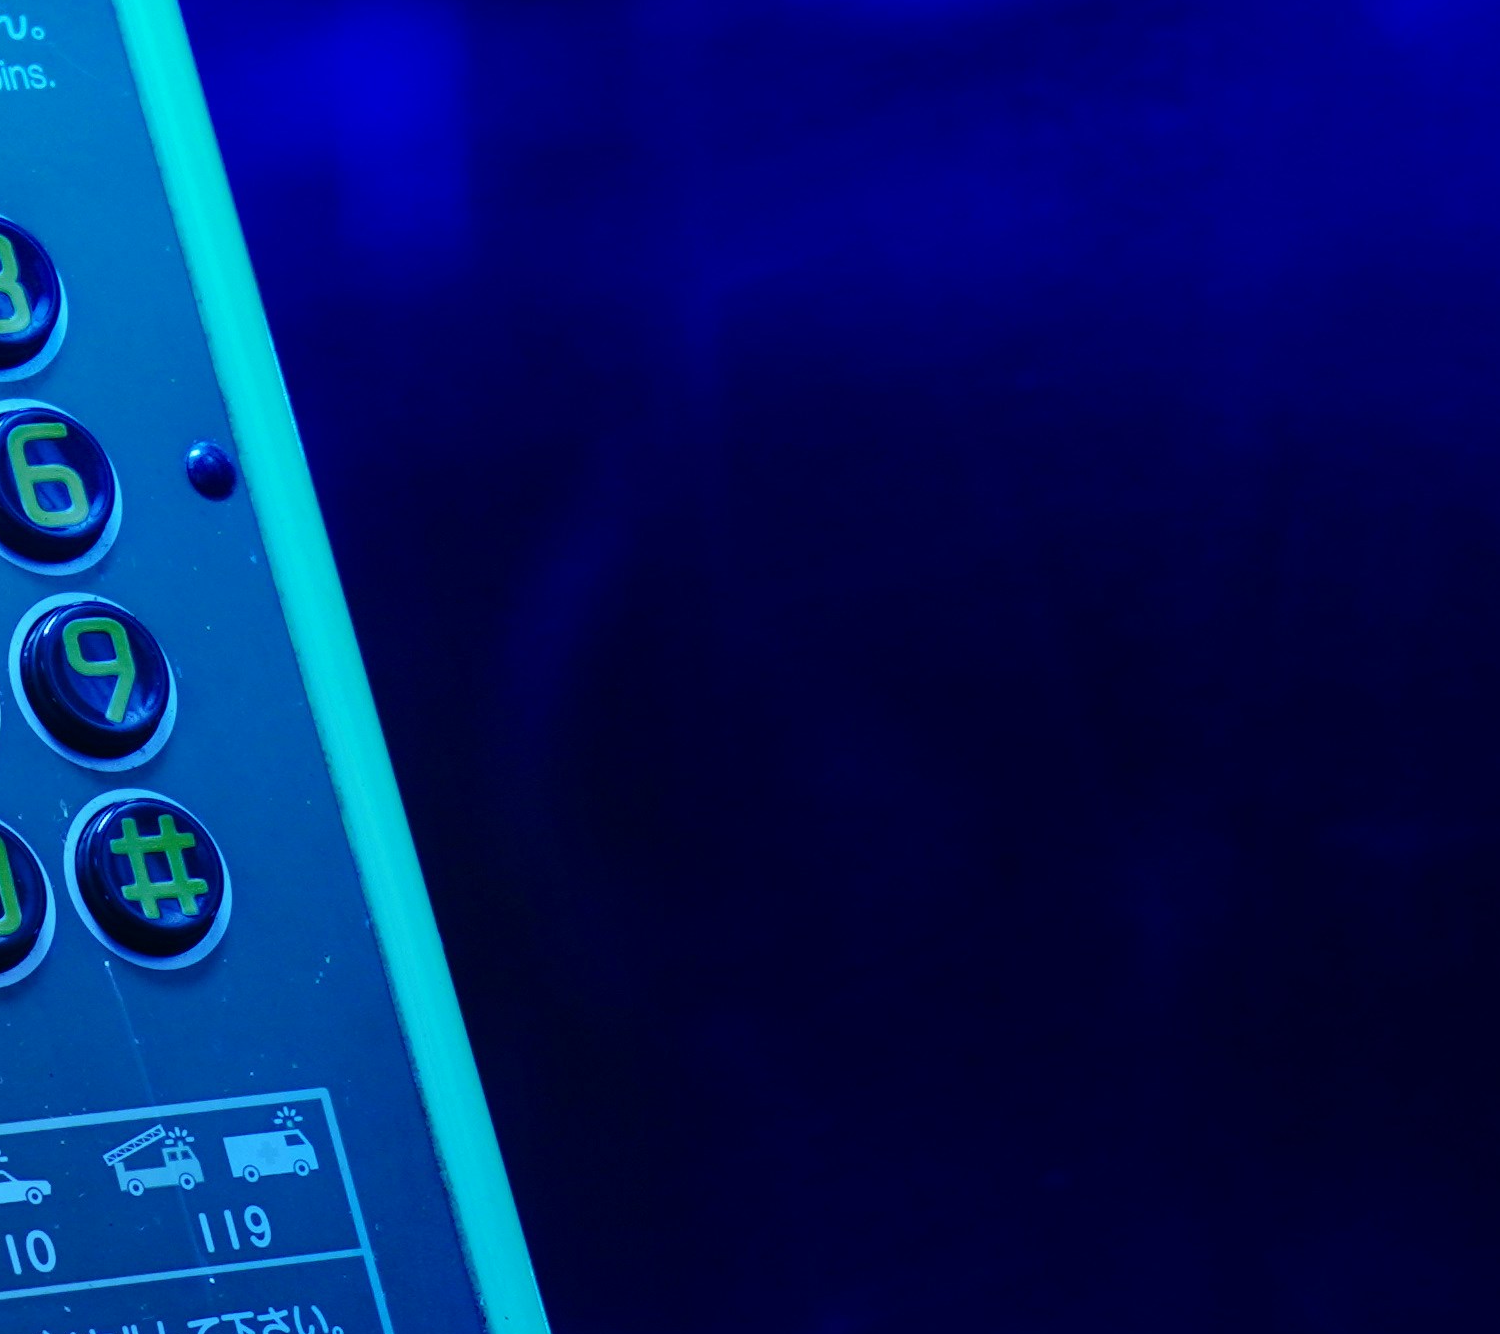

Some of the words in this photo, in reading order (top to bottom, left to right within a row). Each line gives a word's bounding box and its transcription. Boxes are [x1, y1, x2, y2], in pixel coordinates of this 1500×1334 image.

[9, 422, 88, 526] 6
[63, 618, 136, 723] 9
[198, 1205, 273, 1254] 119
